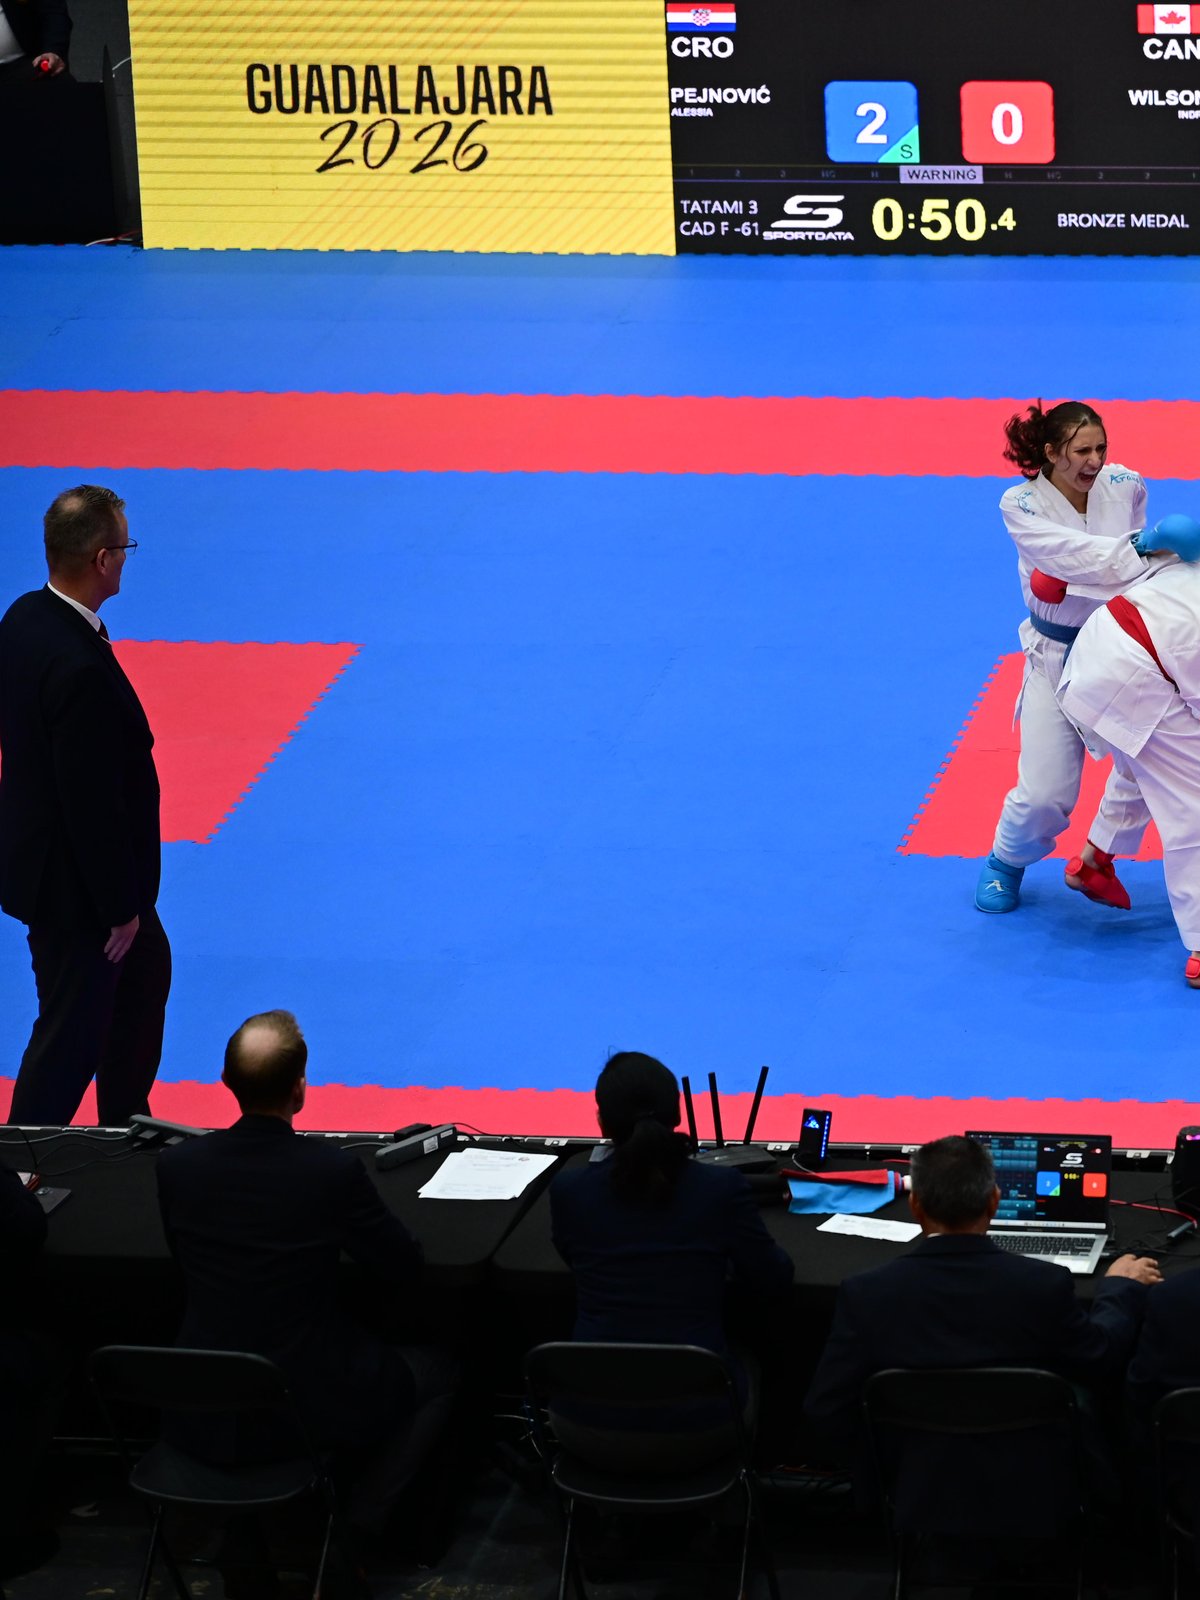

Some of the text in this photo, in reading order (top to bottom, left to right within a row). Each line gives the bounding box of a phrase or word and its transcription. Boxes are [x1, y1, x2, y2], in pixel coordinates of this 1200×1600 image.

[671, 36, 734, 58] CRO
[246, 63, 553, 115] GUADALAJARA
[670, 84, 771, 104] PEJNOVIĆ
[670, 107, 714, 117] ALESSIA
[856, 102, 888, 144] 2
[992, 103, 1023, 145] 0
[316, 118, 489, 173] 2026
[900, 144, 913, 159] S
[907, 168, 977, 181] WARNING
[680, 199, 759, 215] TATAMI 3
[679, 221, 759, 237] CAD F -61
[871, 198, 1017, 242] 0:50.4
[1057, 213, 1190, 229] BRONZE MEDAL
[762, 230, 855, 241] SPORTDATA
